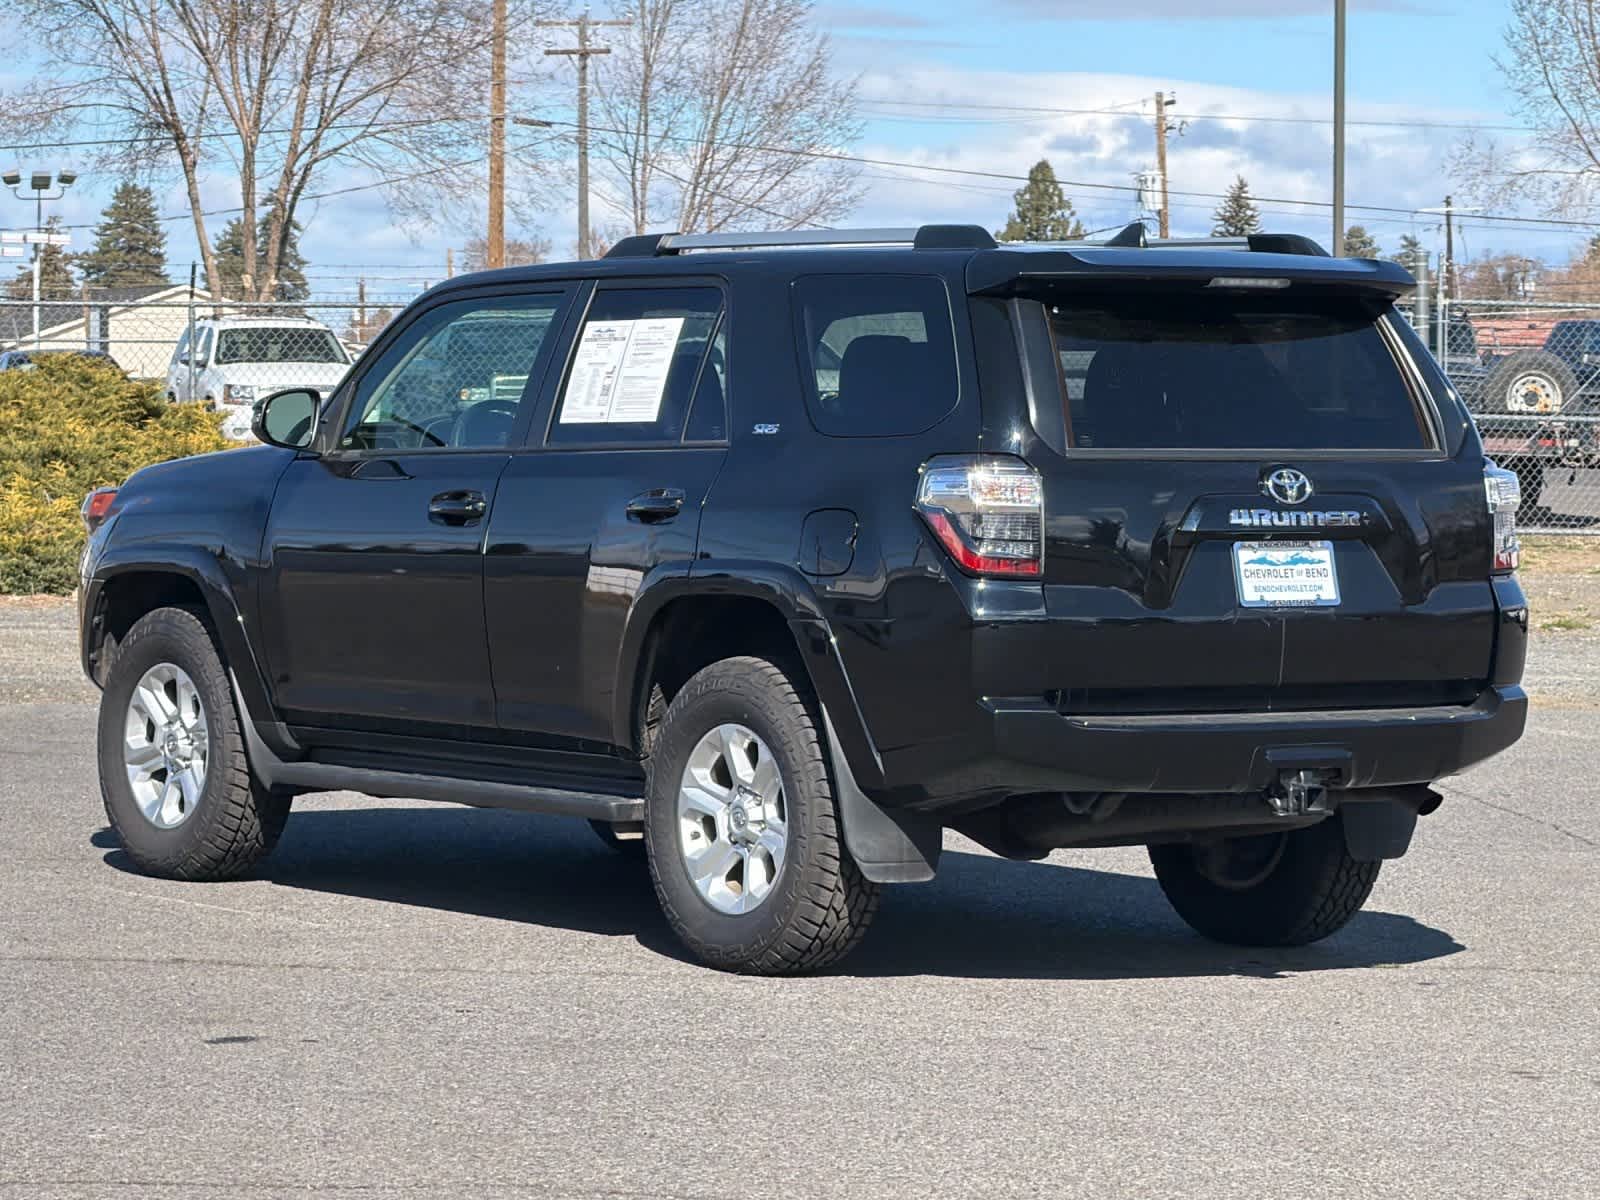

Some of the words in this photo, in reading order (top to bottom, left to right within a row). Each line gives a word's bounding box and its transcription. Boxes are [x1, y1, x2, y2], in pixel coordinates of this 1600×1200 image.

[1243, 568, 1295, 579] CHEVROLET
[1305, 568, 1329, 578] BEND
[1254, 584, 1324, 593] BENDCHEVROLET.COM
